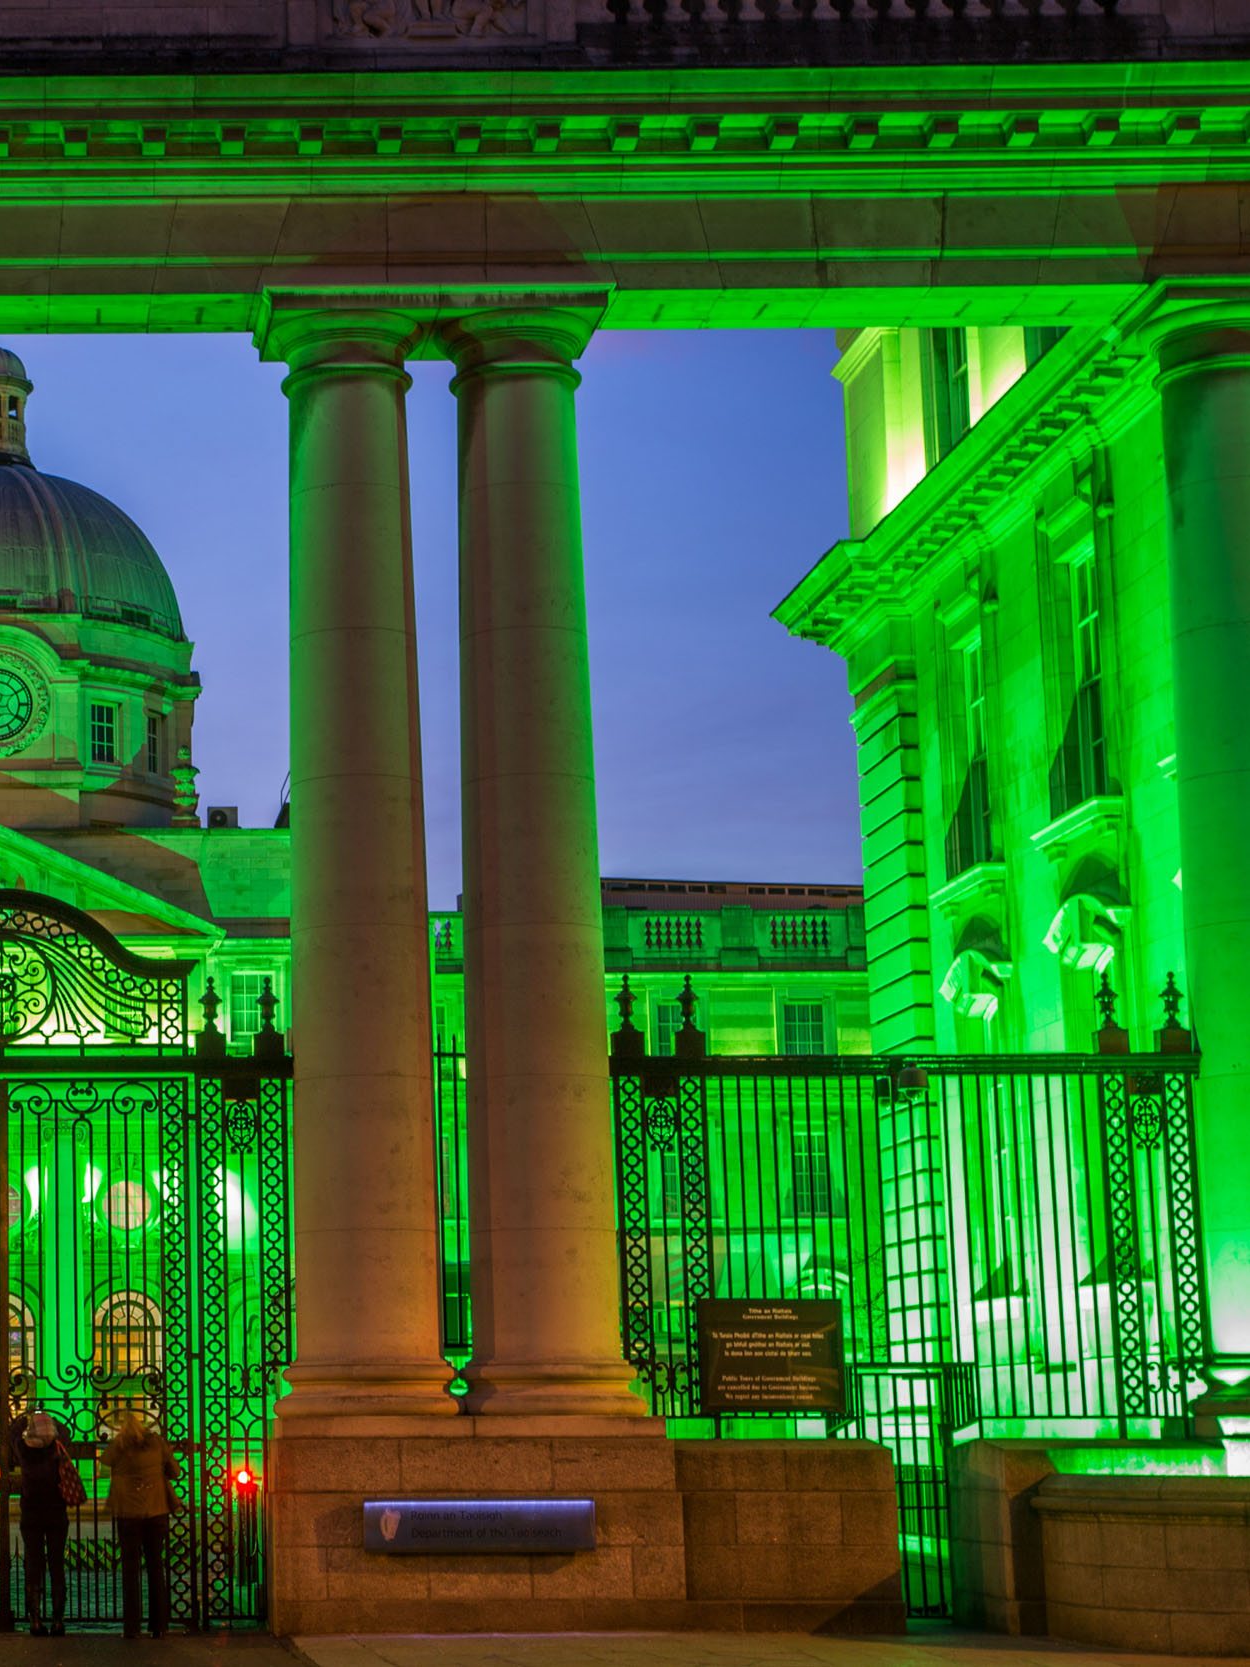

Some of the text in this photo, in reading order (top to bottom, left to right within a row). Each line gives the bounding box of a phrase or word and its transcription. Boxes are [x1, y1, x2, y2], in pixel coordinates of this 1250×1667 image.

[411, 1511, 502, 1521] Roinn an Taoisigh
[412, 1528, 561, 1539] Department of the Taoiseach
